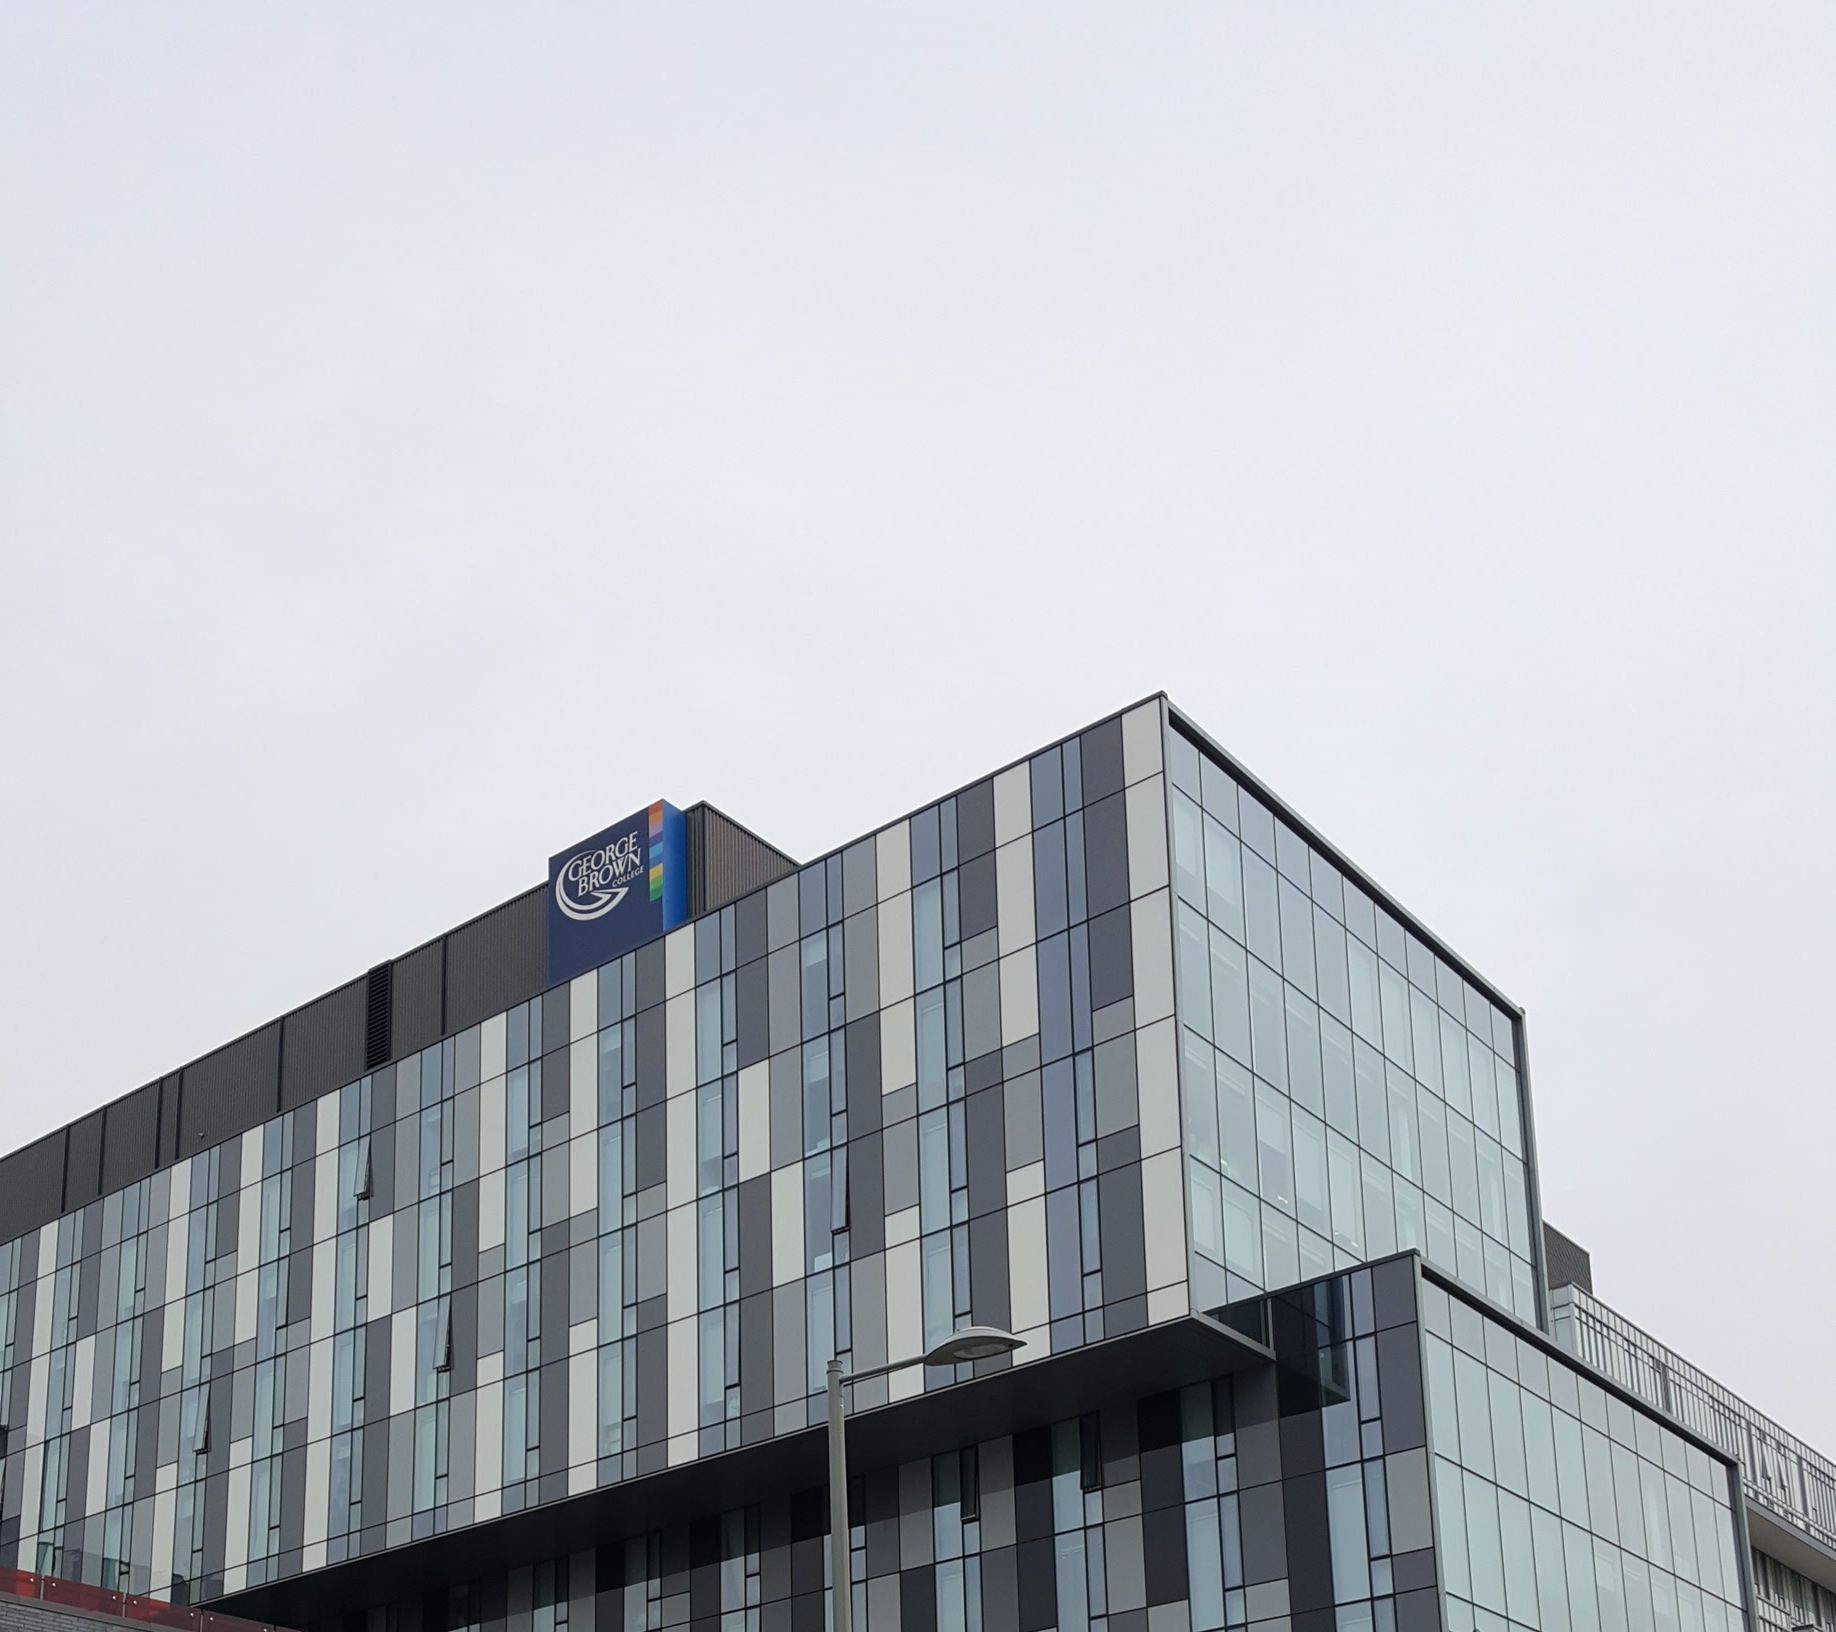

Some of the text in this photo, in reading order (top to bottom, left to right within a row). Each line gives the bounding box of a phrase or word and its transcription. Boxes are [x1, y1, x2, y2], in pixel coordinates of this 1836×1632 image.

[568, 831, 638, 881] GEORGE
[578, 847, 641, 897] BROWN
[612, 865, 644, 888] COLLEGE
